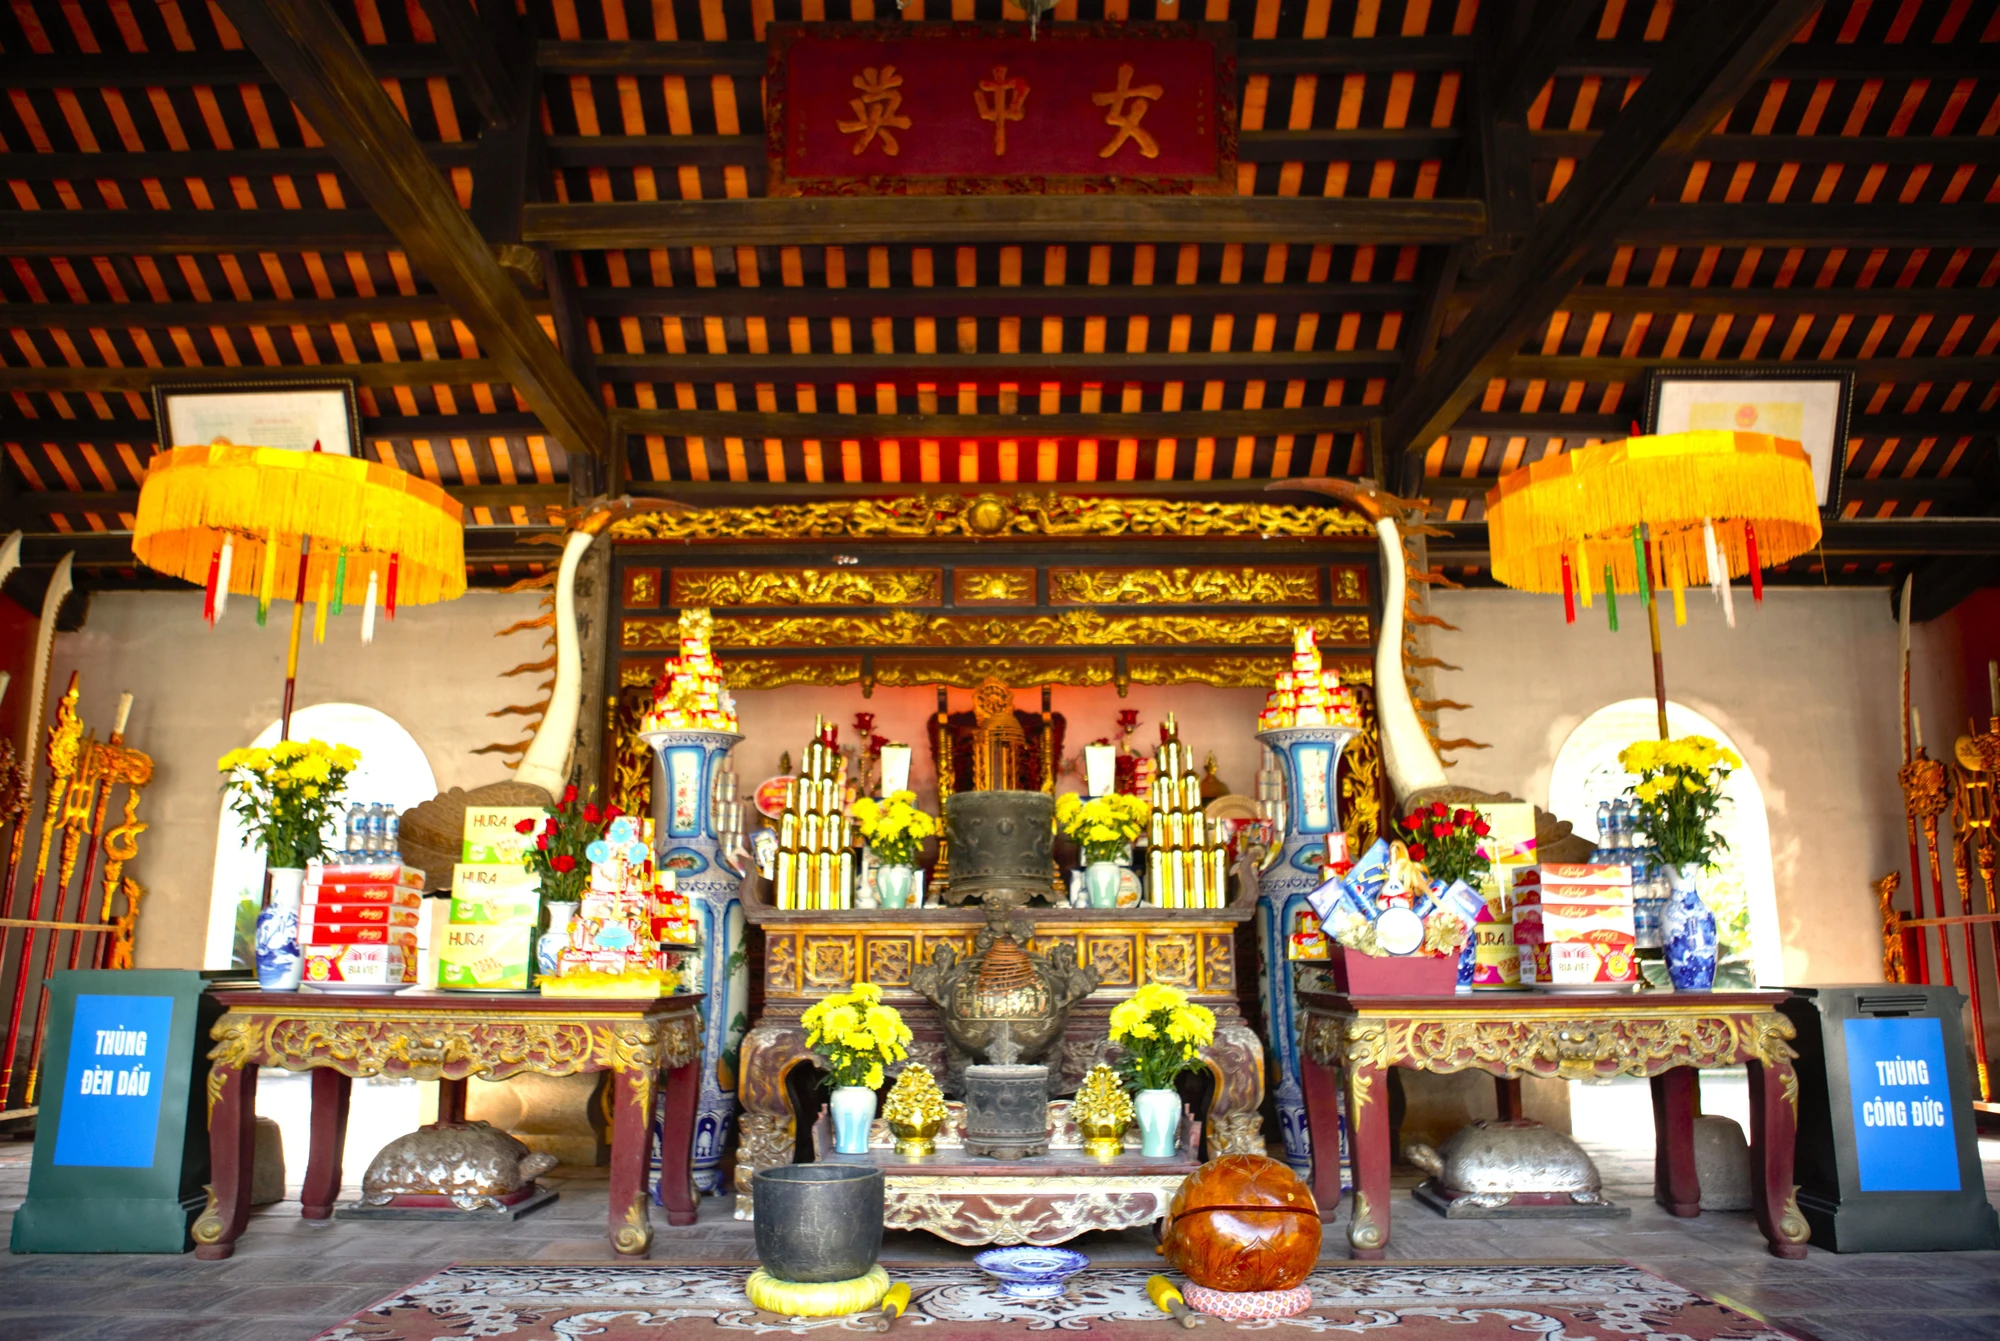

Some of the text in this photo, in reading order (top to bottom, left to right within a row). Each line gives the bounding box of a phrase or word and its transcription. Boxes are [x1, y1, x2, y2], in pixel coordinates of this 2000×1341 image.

[473, 814, 507, 828] HURA
[462, 871, 497, 884] HURA
[449, 932, 485, 946] HURA
[1558, 963, 1572, 972] BIA
[95, 1024, 148, 1056] THÙNG
[80, 1063, 151, 1097] ĐÈN DẦU
[1875, 1055, 1930, 1086] THÙNG
[1862, 1095, 1945, 1128] CÔNG ĐỨC
